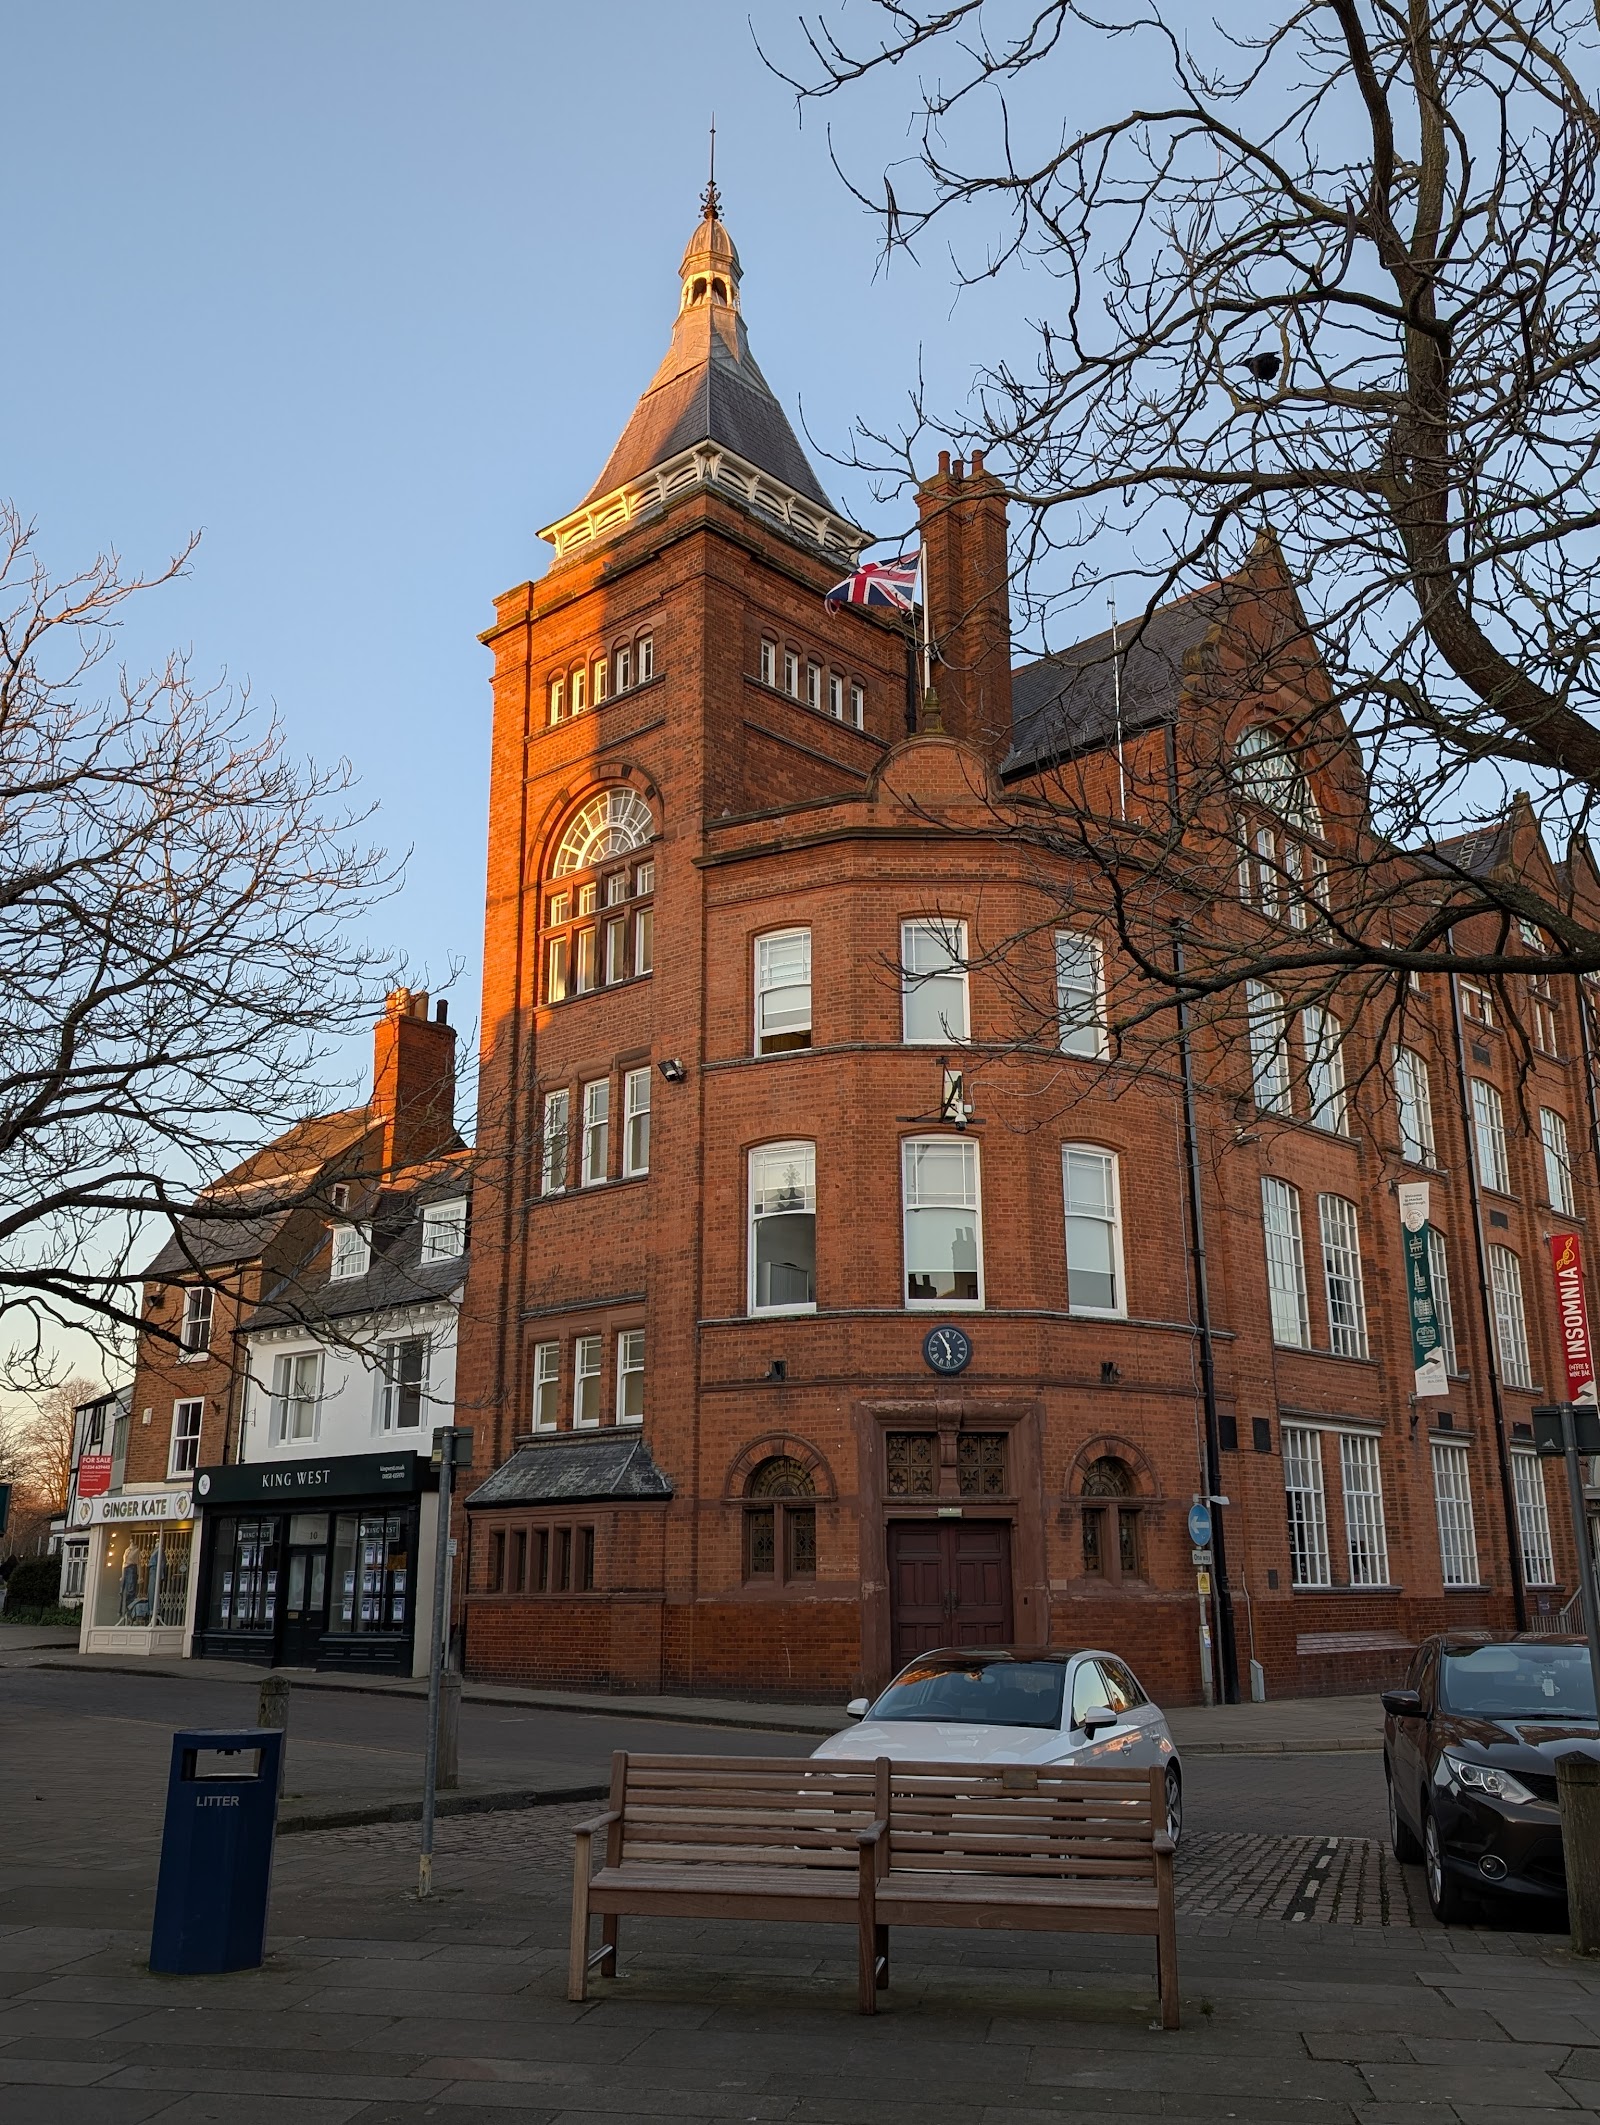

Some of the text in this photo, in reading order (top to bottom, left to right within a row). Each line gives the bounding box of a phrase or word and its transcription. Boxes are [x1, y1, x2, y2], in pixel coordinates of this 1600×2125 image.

[1558, 1266, 1587, 1360] INSOMNIA
[262, 1469, 330, 1488] KING WEST
[102, 1499, 167, 1518] GINGER KATE
[309, 1531, 318, 1540] 10
[196, 1796, 240, 1807] LITTER
